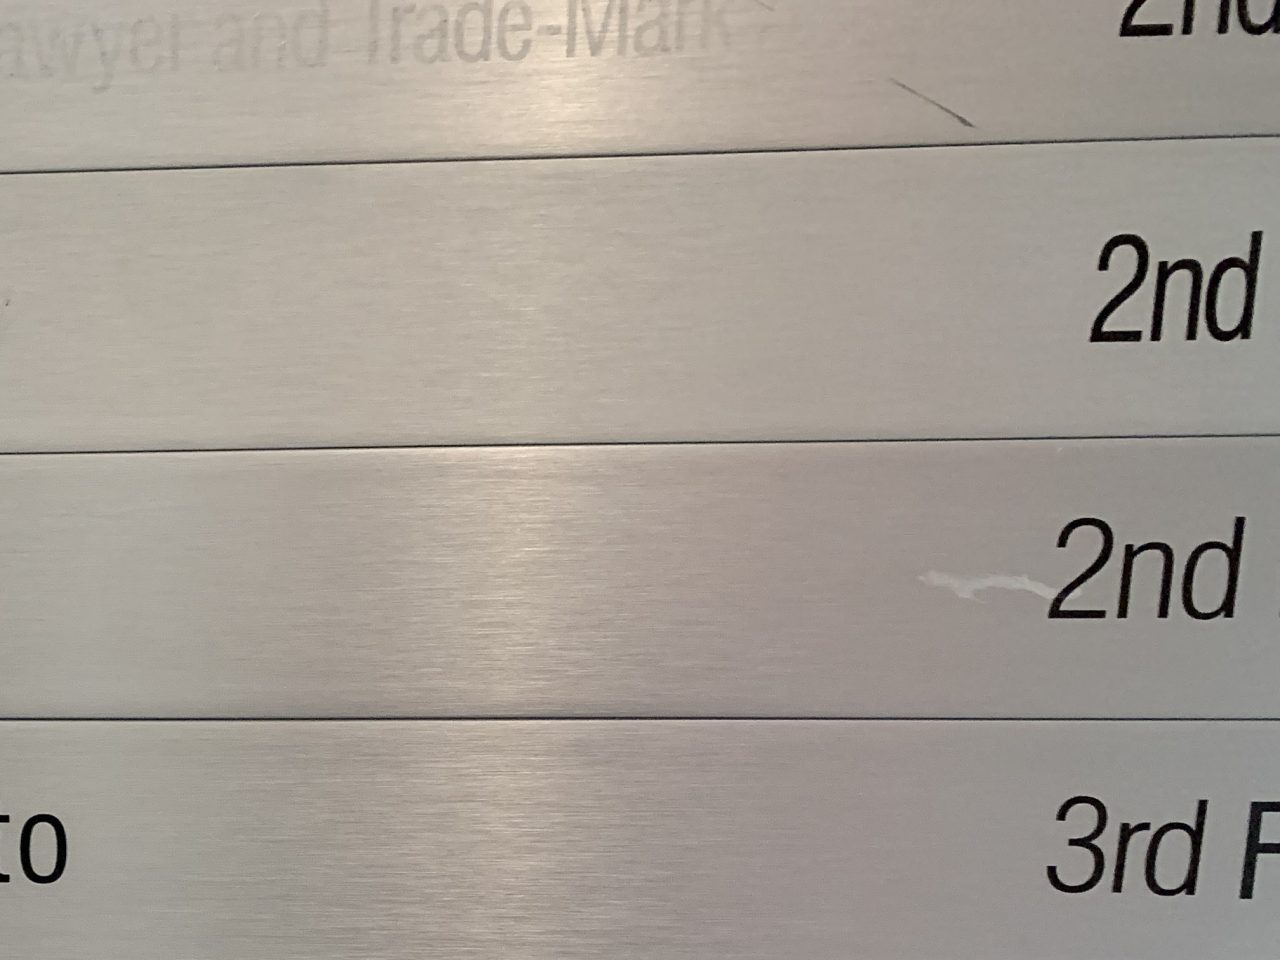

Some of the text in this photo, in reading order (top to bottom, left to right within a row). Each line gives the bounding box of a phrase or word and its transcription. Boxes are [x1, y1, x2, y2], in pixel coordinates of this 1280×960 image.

[1089, 230, 1264, 343] 2nd
[1047, 516, 1247, 621] 2nd
[1046, 795, 1209, 897] 3rd
